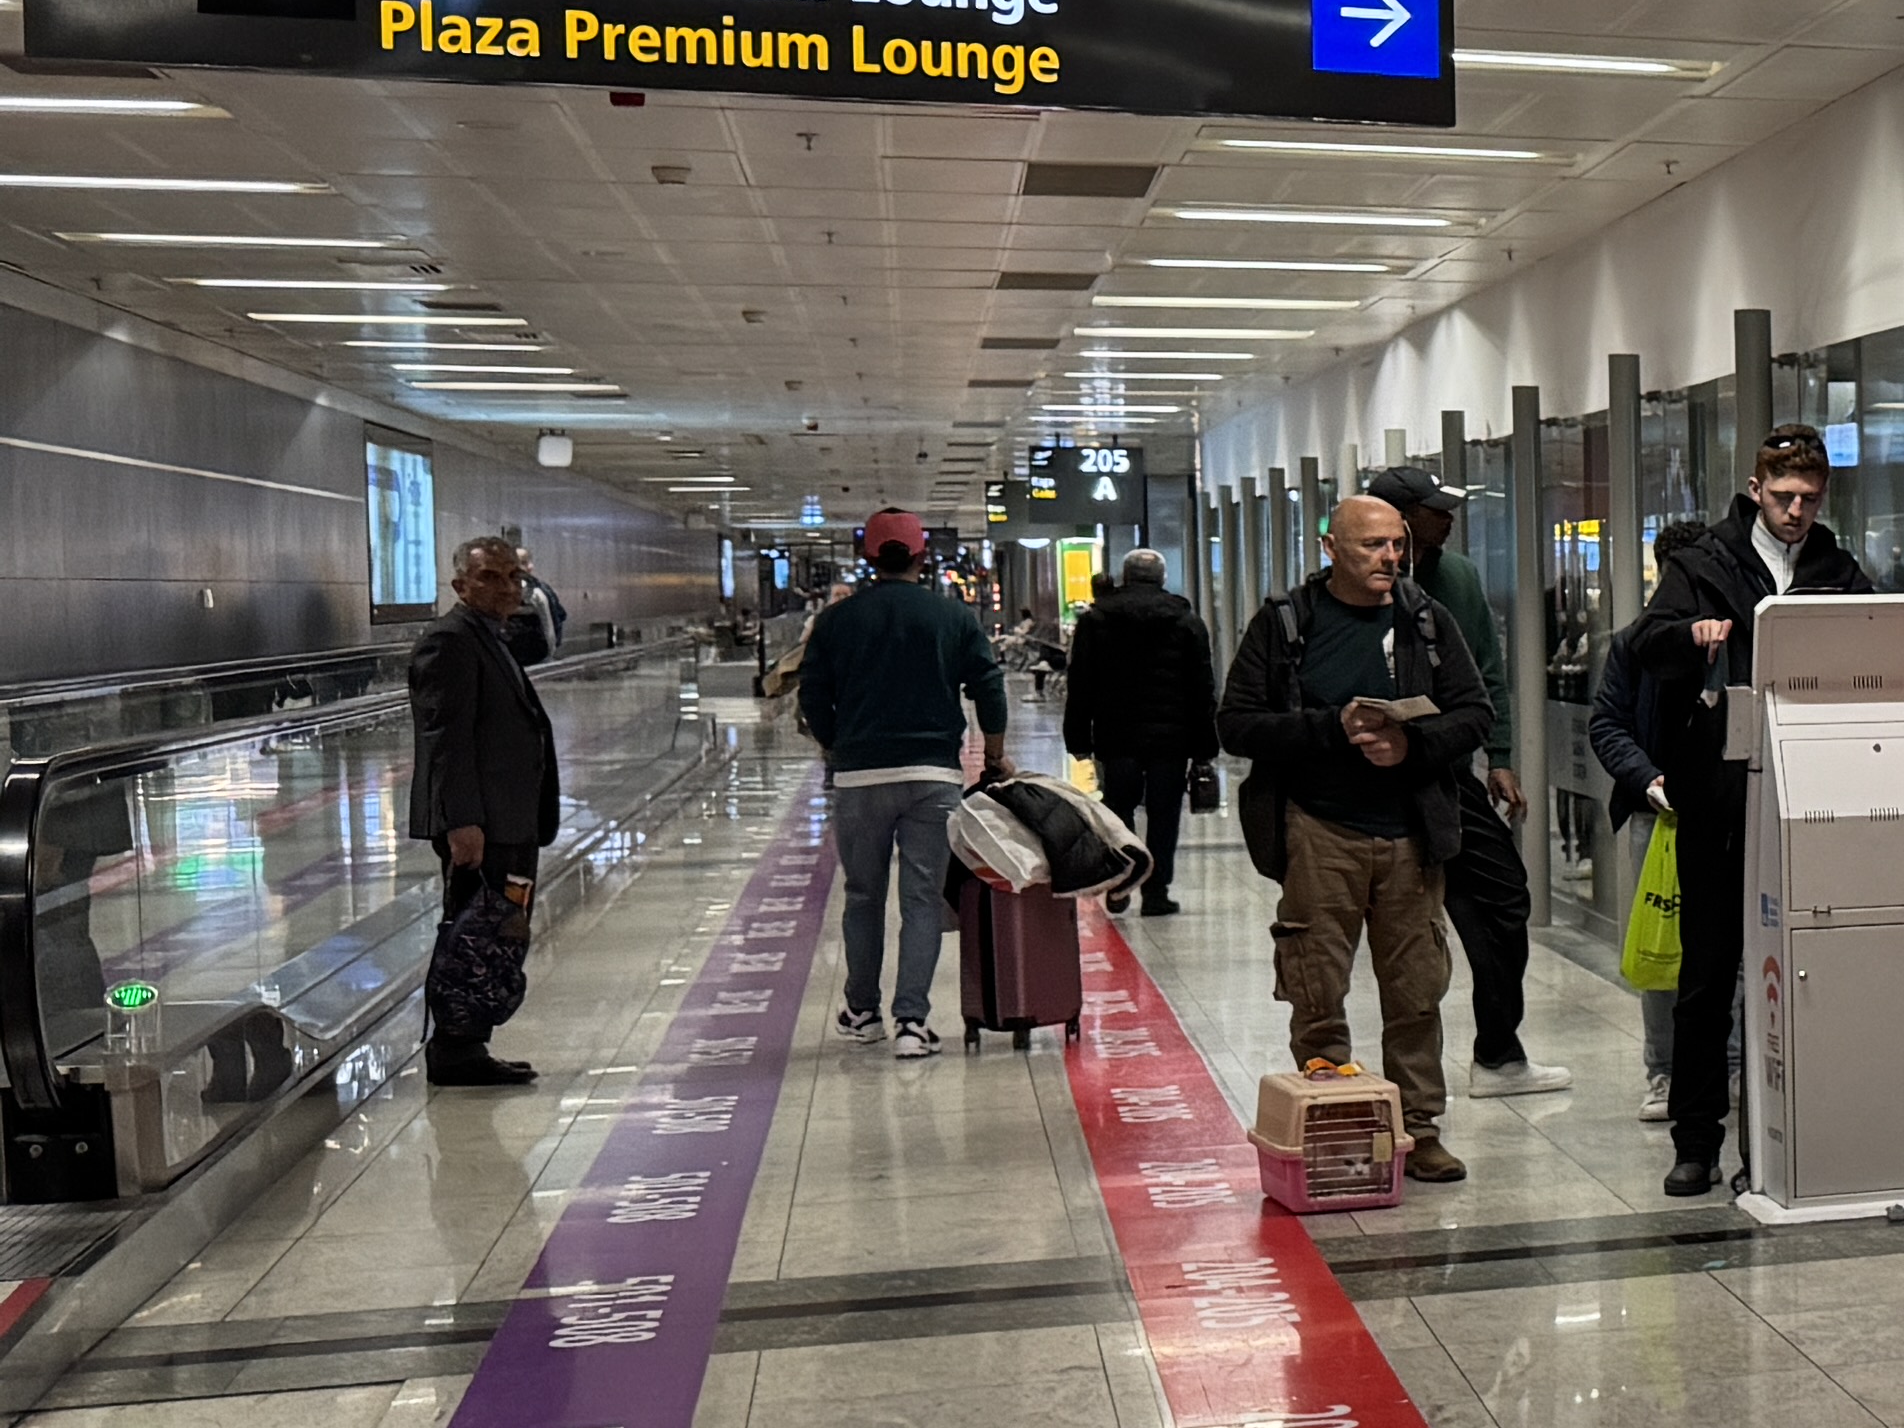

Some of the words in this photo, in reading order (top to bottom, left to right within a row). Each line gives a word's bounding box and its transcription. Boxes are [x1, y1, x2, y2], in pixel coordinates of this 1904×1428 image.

[379, 0, 541, 58] Plaza
[564, 9, 829, 71] Premium
[851, 25, 1061, 95] Lounge
[1078, 448, 1131, 473] 205
[1092, 475, 1118, 501] A
[606, 1170, 711, 1224] 501-508
[548, 1274, 675, 1349] 501-508
[1180, 1256, 1301, 1330] 204-205
